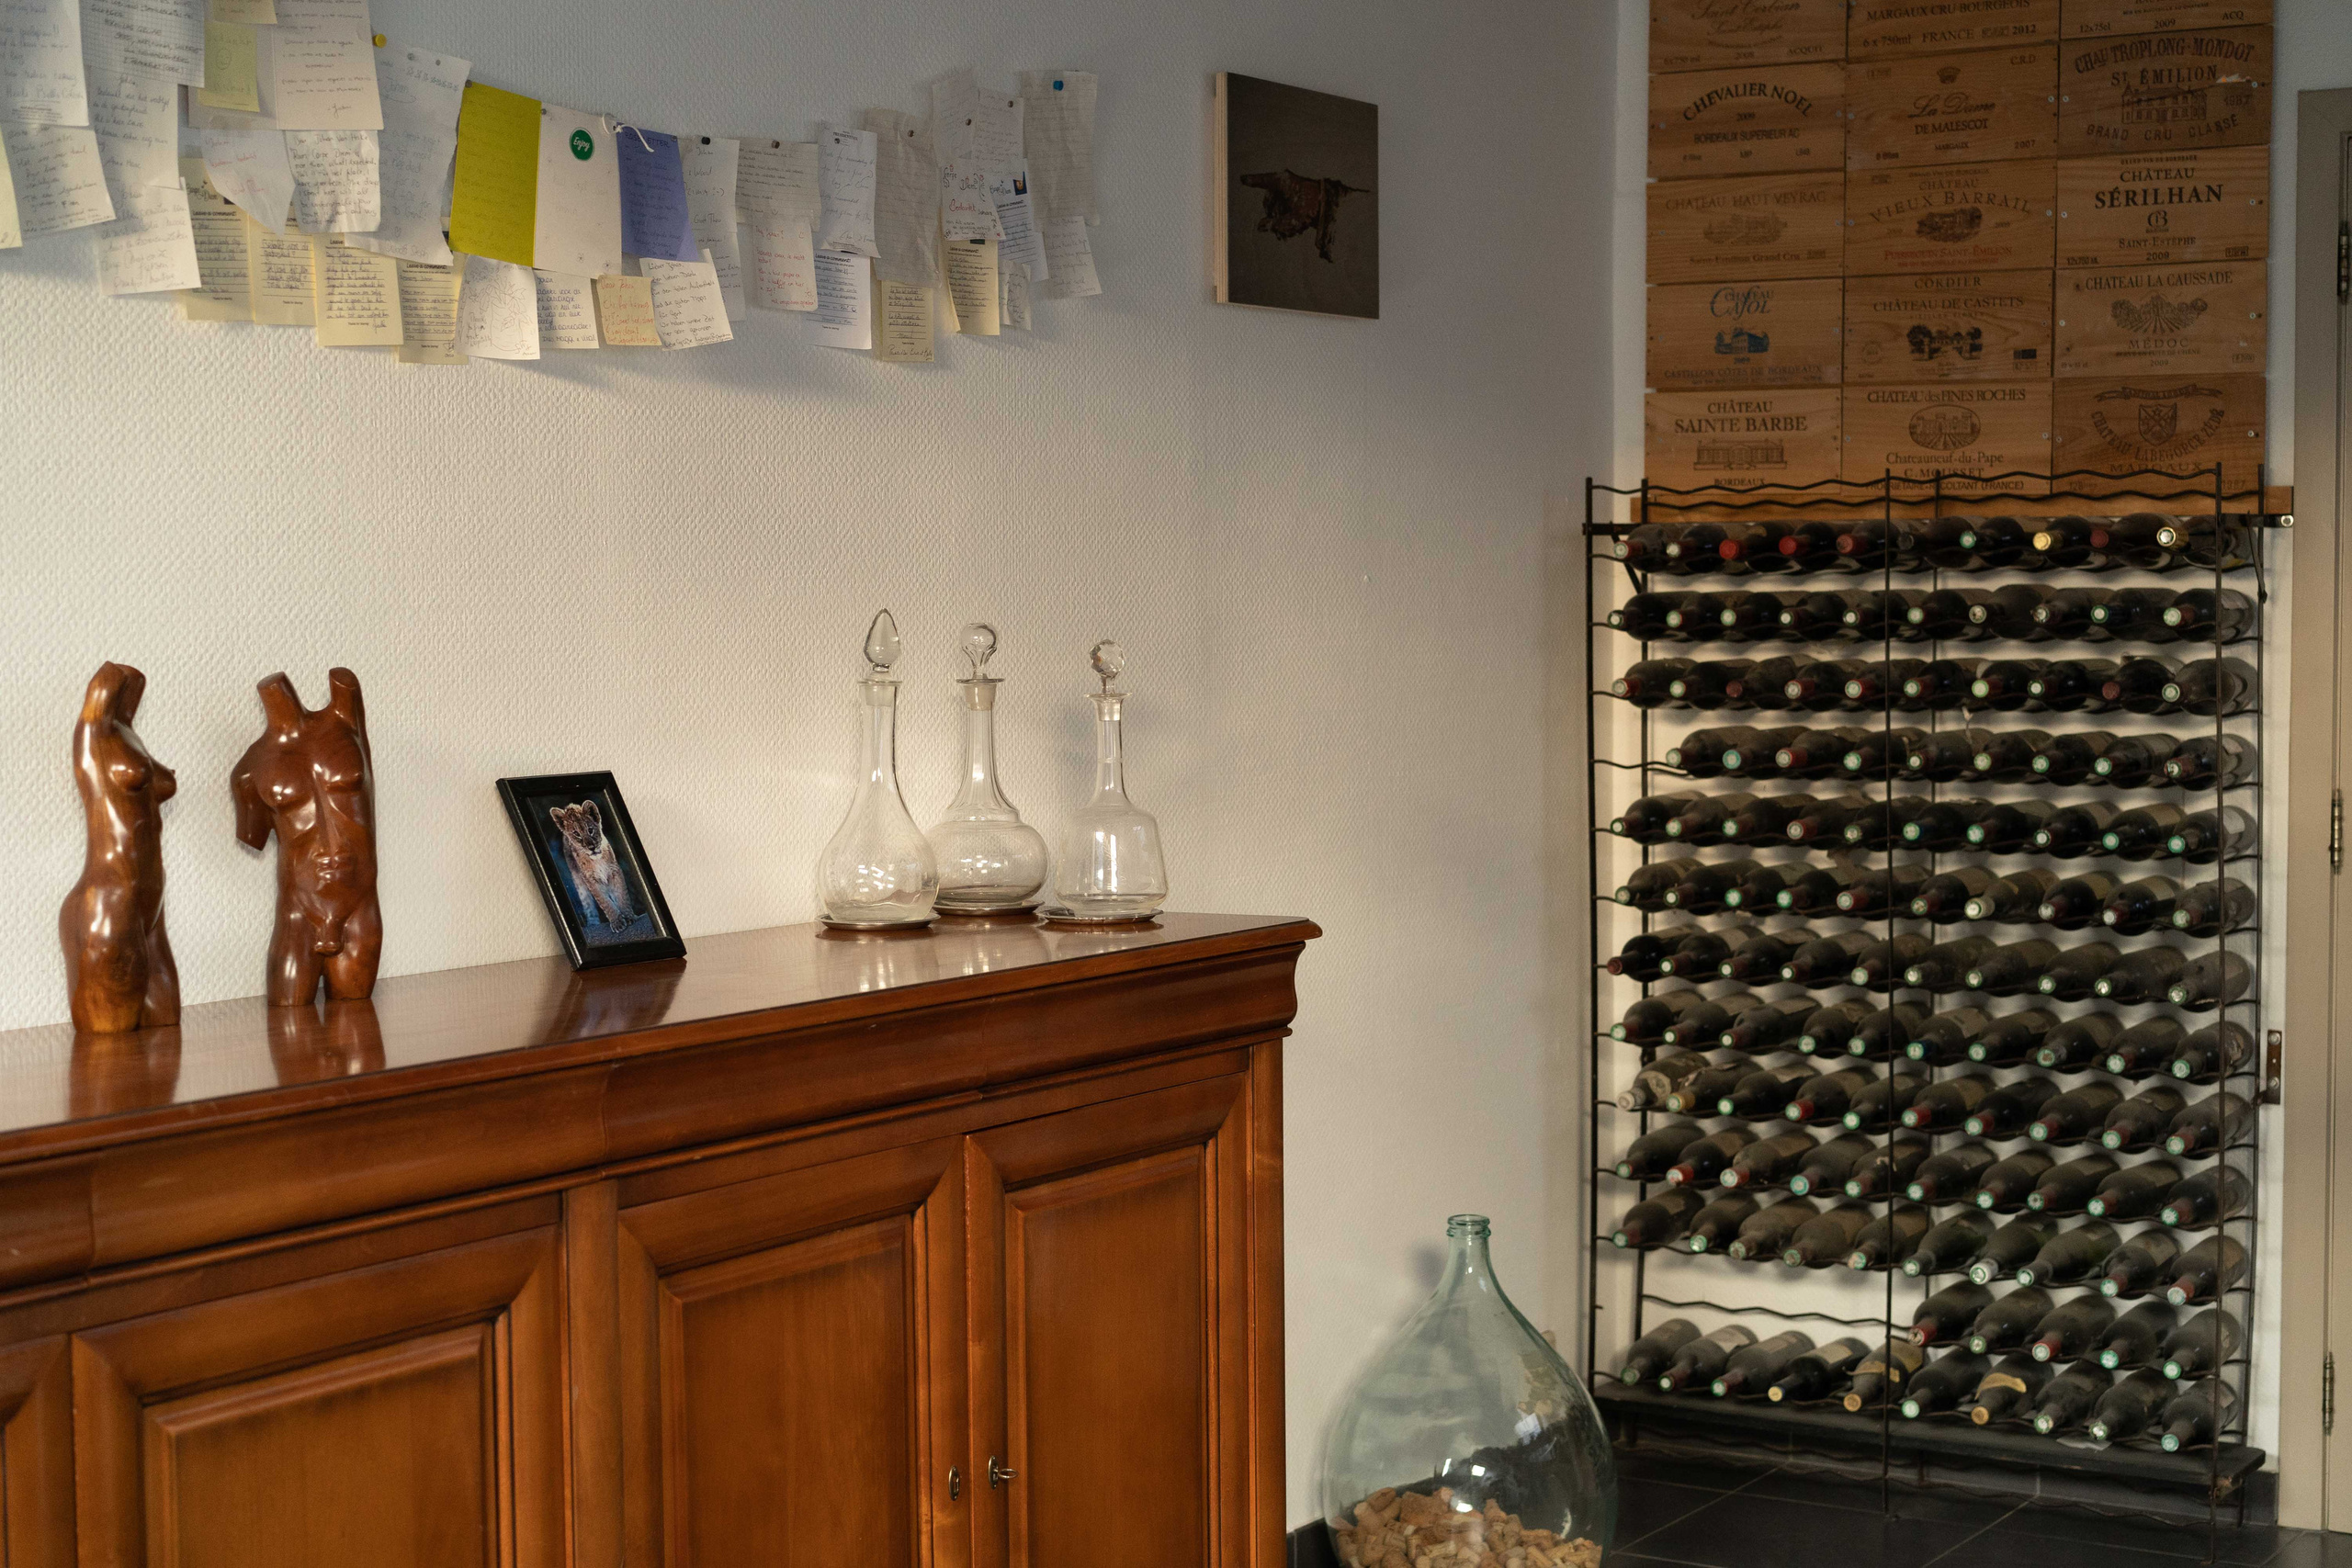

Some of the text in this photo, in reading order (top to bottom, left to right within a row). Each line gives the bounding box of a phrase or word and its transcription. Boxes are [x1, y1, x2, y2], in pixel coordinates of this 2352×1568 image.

[1866, 0, 2031, 22] MARGAUX CRU BOURGEOIS
[2222, 10, 2245, 21] ACQ
[2154, 18, 2177, 30] 2009
[1922, 28, 1974, 43] FRANCE
[2012, 24, 2037, 37] 2012
[1682, 82, 1814, 122] CHEVALIER NOEL
[1915, 118, 1989, 135] DE MALESCOT
[2086, 123, 2129, 141] GRAND
[2144, 129, 2173, 141] CRU
[573, 137, 591, 152] Enjoy
[1693, 132, 1738, 144] BORDEAUX
[2120, 167, 2196, 183] CHÂTEAU
[2094, 184, 2223, 209] SÉRILHAN
[1869, 190, 2032, 223] VIEUX BARRAIL
[2146, 251, 2169, 262] 2009
[1914, 276, 1982, 290] CORDIER
[2085, 271, 2233, 290] CHATEAU LA CAUSSADE
[1872, 295, 2025, 312] CHÂTEAU DE CASTETS
[2129, 337, 2189, 350] MÉDOC
[1867, 389, 1923, 403] CHATEAU
[1941, 389, 1973, 402] FINES
[1976, 389, 2026, 401] ROCHES
[1707, 399, 1773, 414] CHÂTEAU
[1674, 415, 1808, 434] SAINTE BARBE
[1713, 478, 1766, 487] BORDEAUX
[1981, 479, 2024, 494] (FRANCE)
